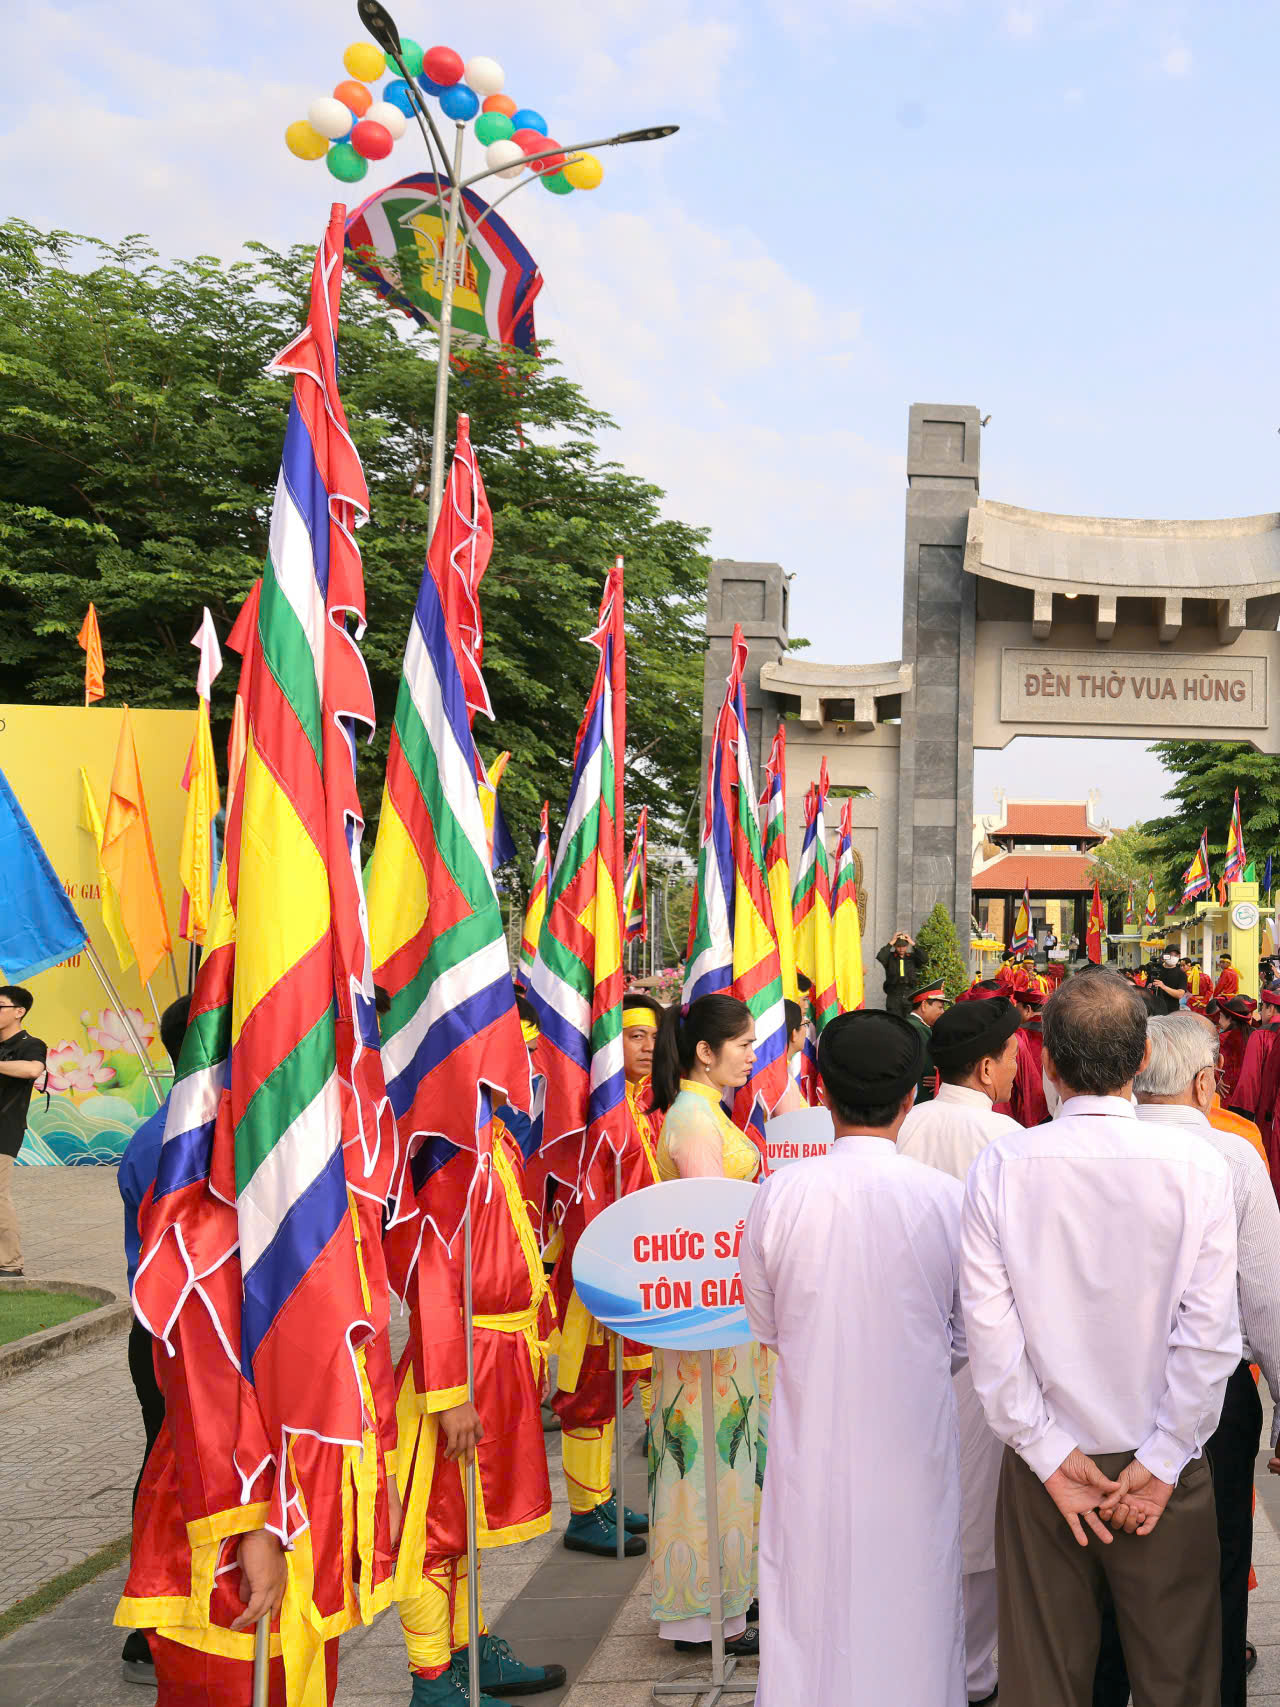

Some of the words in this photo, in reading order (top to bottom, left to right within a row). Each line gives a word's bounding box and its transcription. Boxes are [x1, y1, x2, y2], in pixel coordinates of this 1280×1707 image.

[1077, 670, 1126, 699] THỜ
[1130, 677, 1177, 700] VUA
[1183, 674, 1246, 702] HÙNG
[81, 883, 101, 899] GIA
[765, 1140, 799, 1159] UYÊN
[802, 1143, 827, 1158] BAN
[633, 1227, 705, 1263] CHỨC
[639, 1276, 692, 1311] TÔN
[701, 1272, 745, 1308] GIÁ
